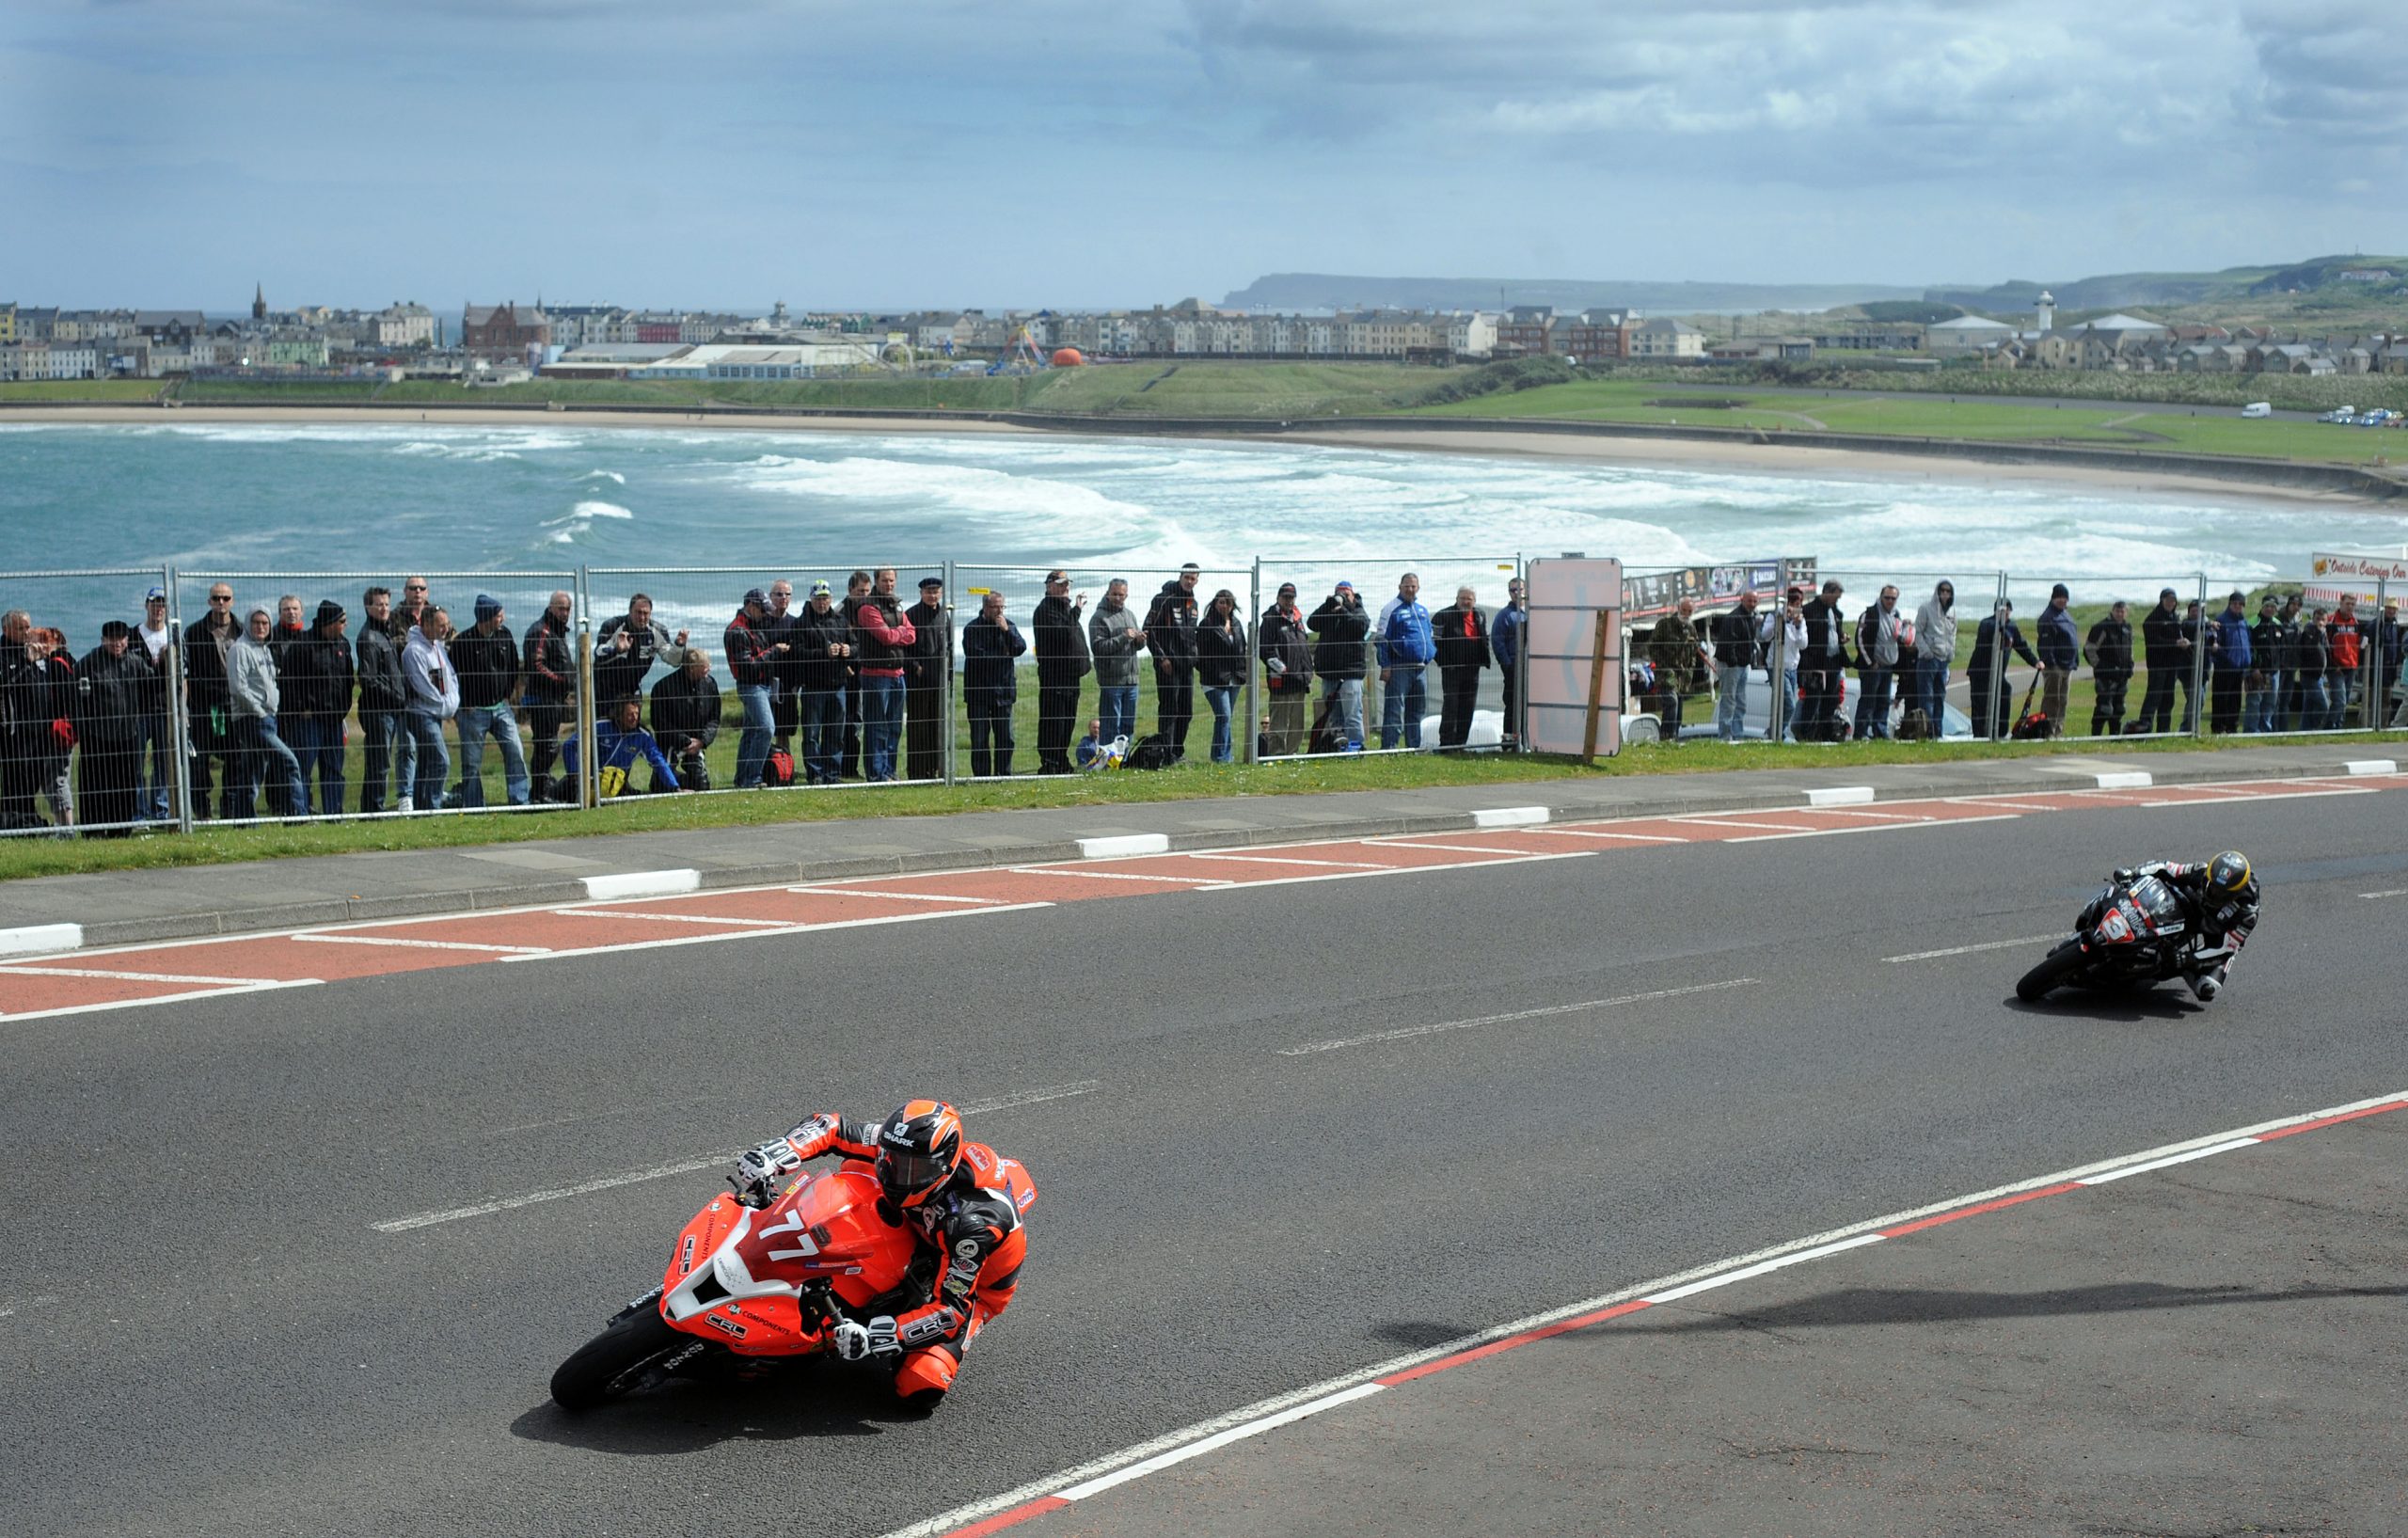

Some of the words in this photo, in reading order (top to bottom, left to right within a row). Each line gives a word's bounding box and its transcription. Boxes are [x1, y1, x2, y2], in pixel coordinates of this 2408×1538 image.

[2359, 560, 2390, 579] Catering
[883, 1131, 915, 1148] SHARK
[702, 1213, 715, 1260] COMPONENTS
[758, 1209, 820, 1261] 77
[742, 1310, 791, 1335] COMPONENTS
[663, 1342, 705, 1370] DUNLOP
